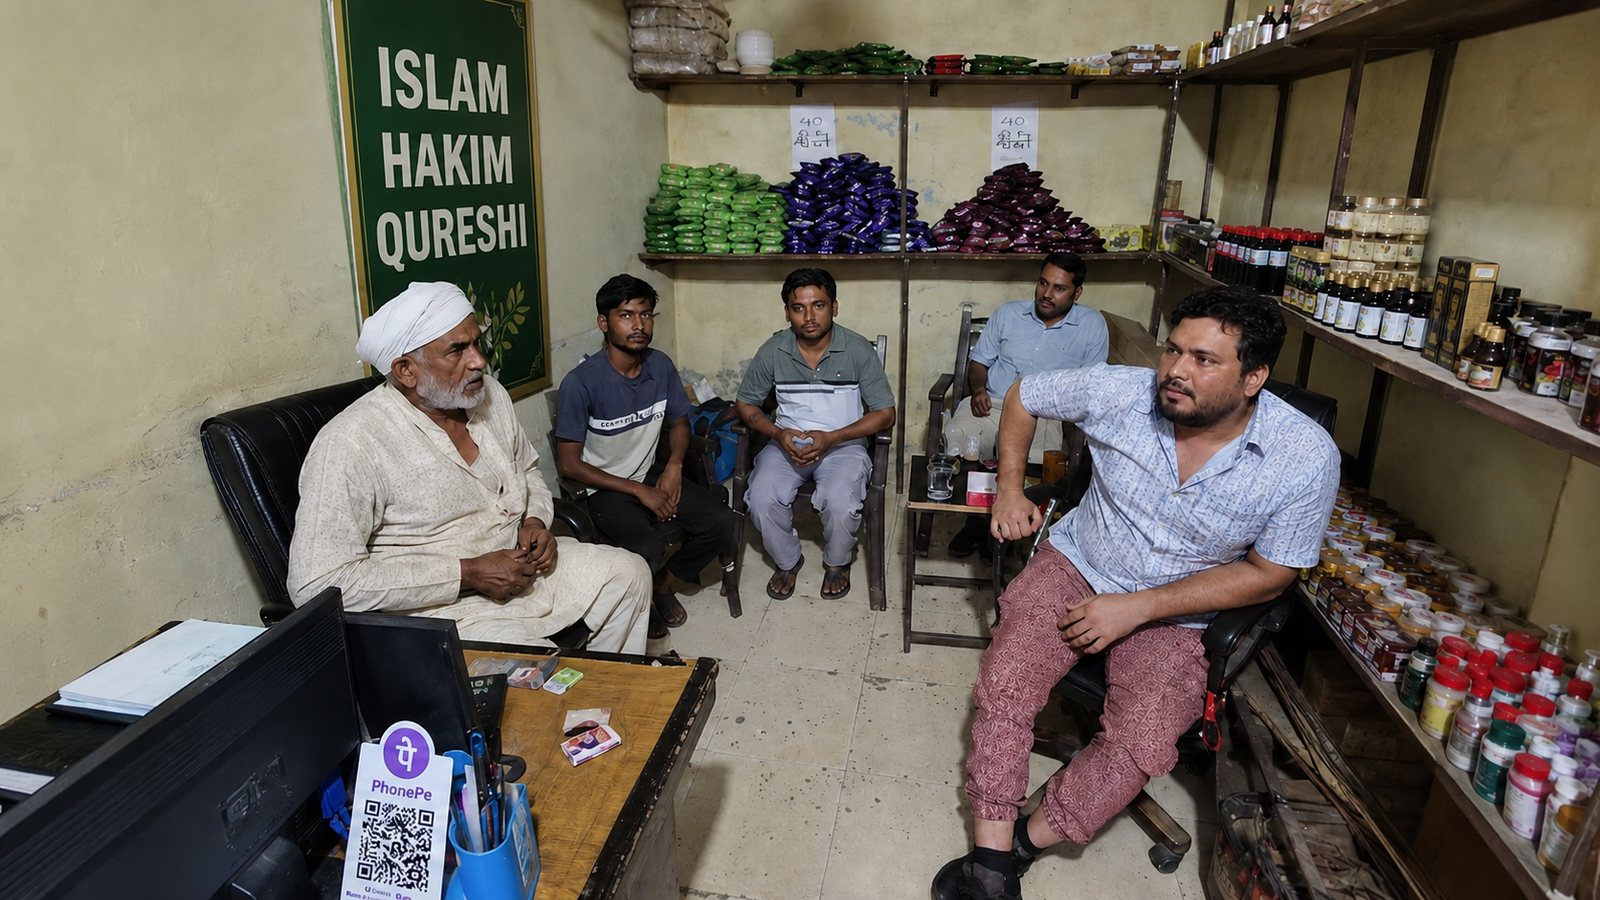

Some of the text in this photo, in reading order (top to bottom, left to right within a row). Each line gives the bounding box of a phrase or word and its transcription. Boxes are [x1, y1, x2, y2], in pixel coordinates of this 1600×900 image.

[378, 46, 509, 115] ISLAM
[799, 116, 823, 127] 40
[1000, 116, 1025, 127] 40
[381, 132, 513, 189] HAKIM
[376, 203, 528, 272] QURESHI
[395, 736, 417, 771] पे
[371, 780, 432, 801] PhonePe
